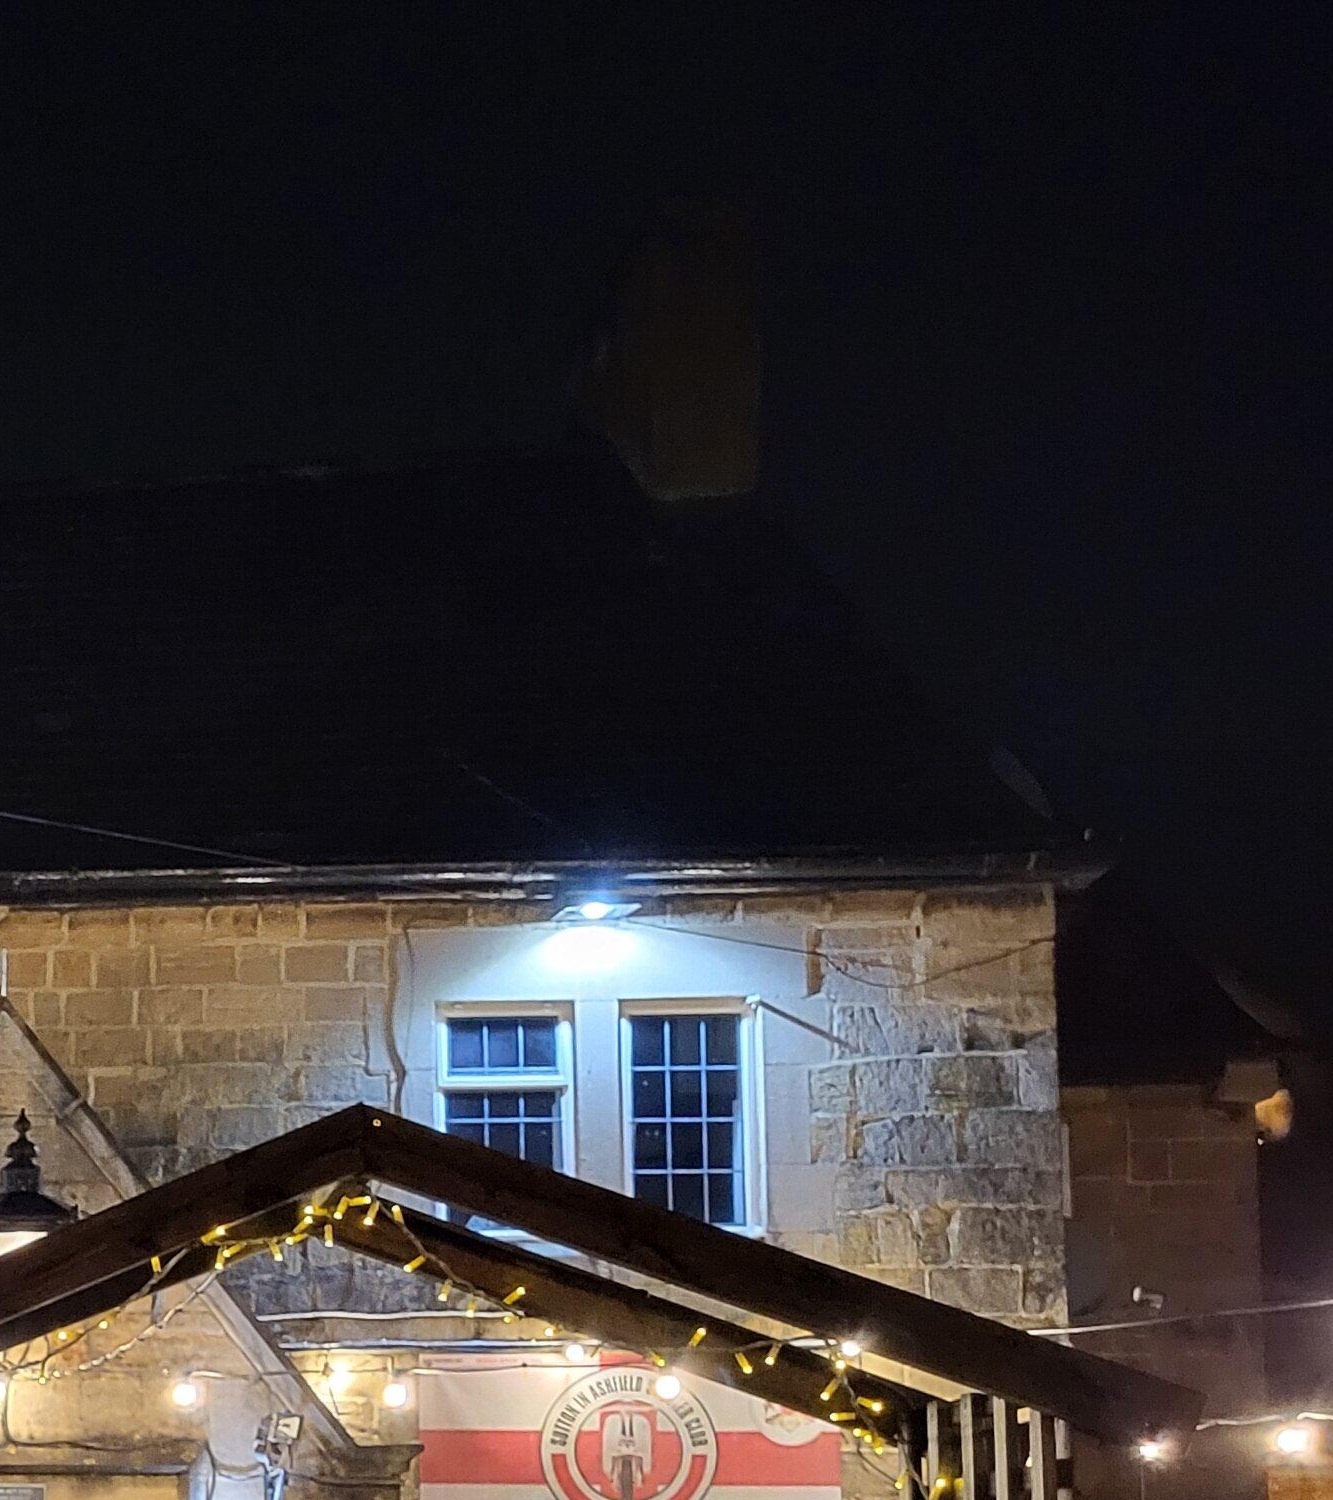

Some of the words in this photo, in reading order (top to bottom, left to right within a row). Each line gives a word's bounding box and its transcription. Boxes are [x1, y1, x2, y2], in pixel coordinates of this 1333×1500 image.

[550, 1403, 582, 1448] SUTTON
[573, 1389, 592, 1410] IN
[588, 1373, 644, 1401] ASHFIELD
